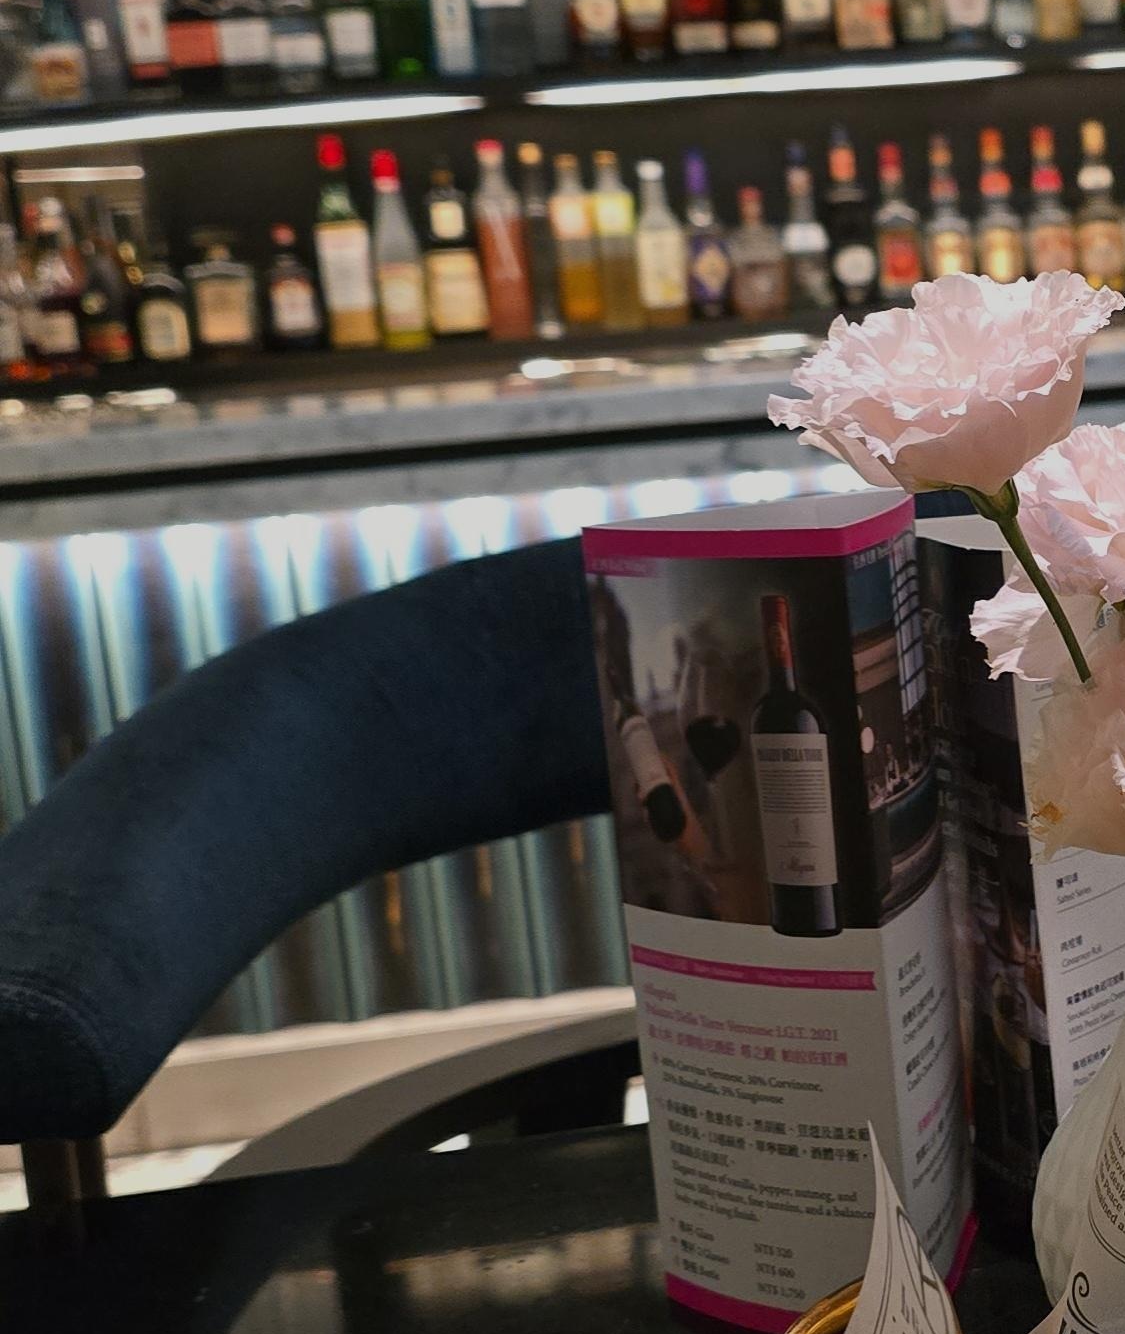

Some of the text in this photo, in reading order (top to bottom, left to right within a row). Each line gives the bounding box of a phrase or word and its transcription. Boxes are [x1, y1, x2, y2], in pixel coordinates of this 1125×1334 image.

[810, 1028, 839, 1041] 2021
[837, 1192, 858, 1202] and
[805, 1206, 824, 1216] and
[834, 1207, 875, 1219] balance
